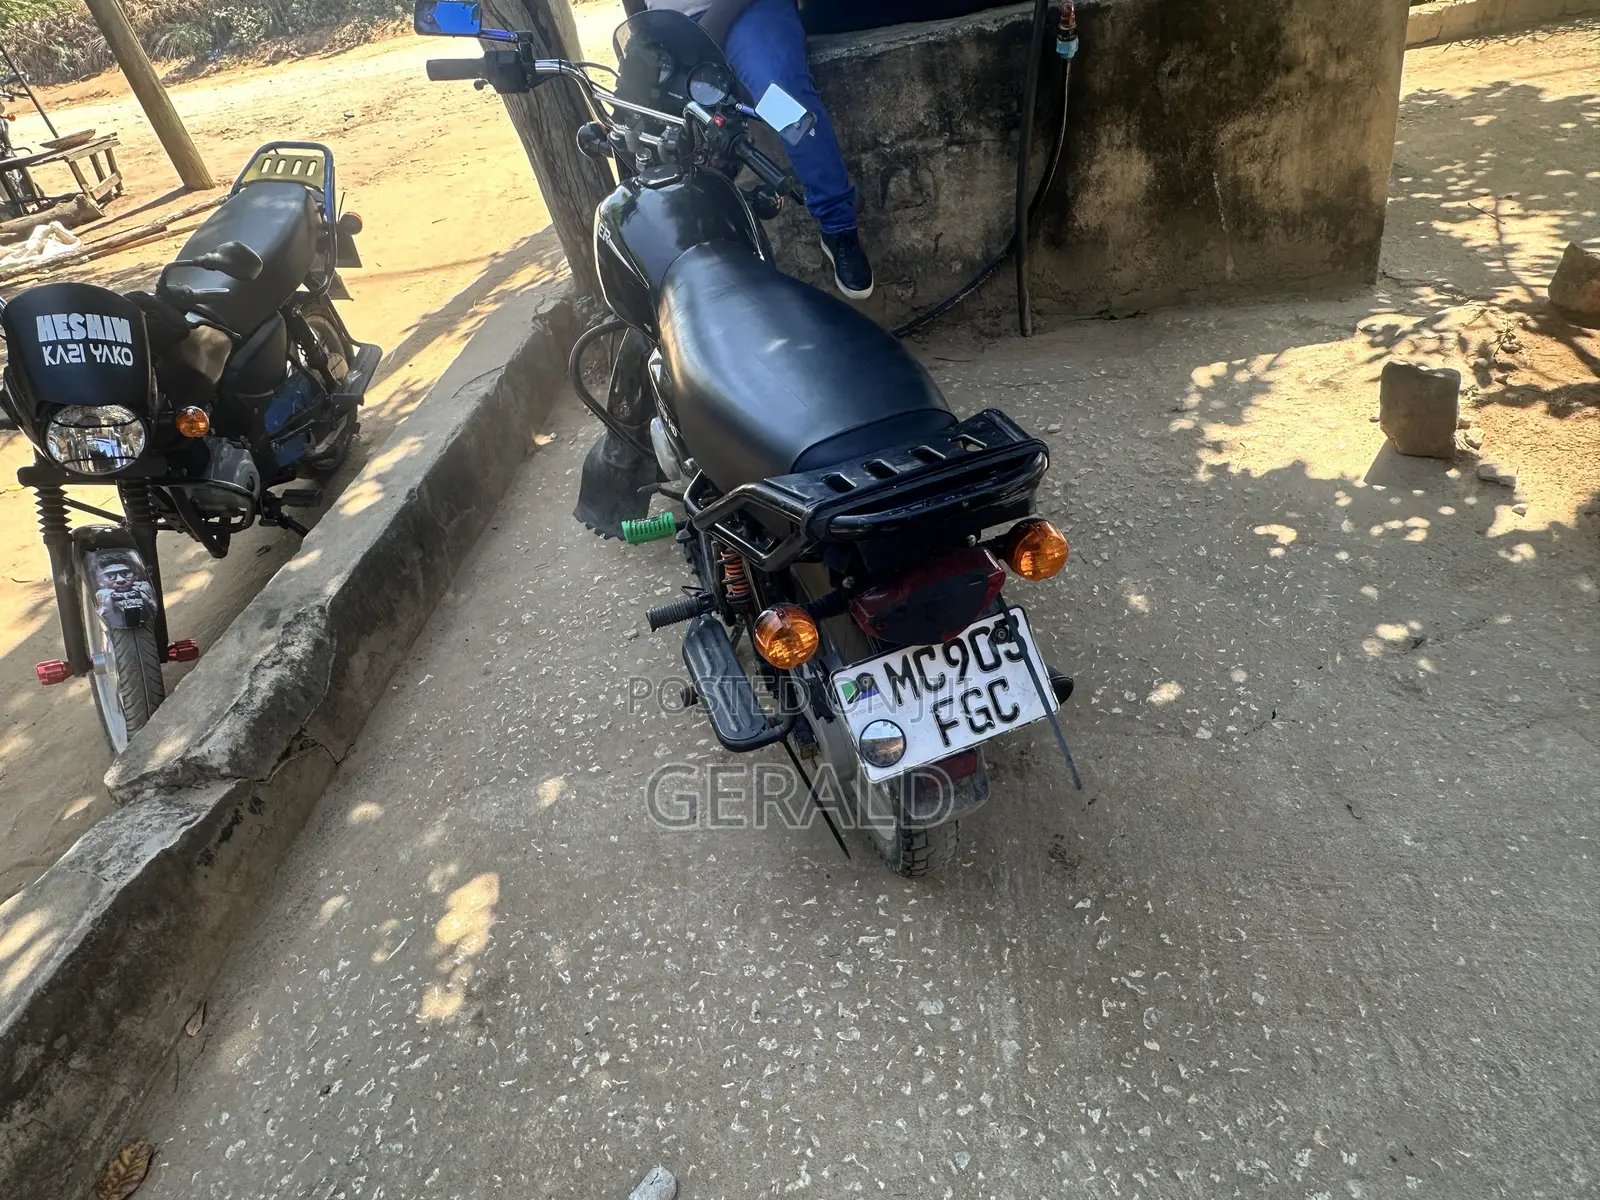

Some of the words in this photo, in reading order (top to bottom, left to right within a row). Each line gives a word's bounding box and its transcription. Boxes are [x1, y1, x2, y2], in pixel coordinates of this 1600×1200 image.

[36, 313, 132, 344] HESHIM
[42, 343, 86, 366] KAZI
[89, 343, 134, 366] YAKO
[929, 675, 1021, 748] FGC
